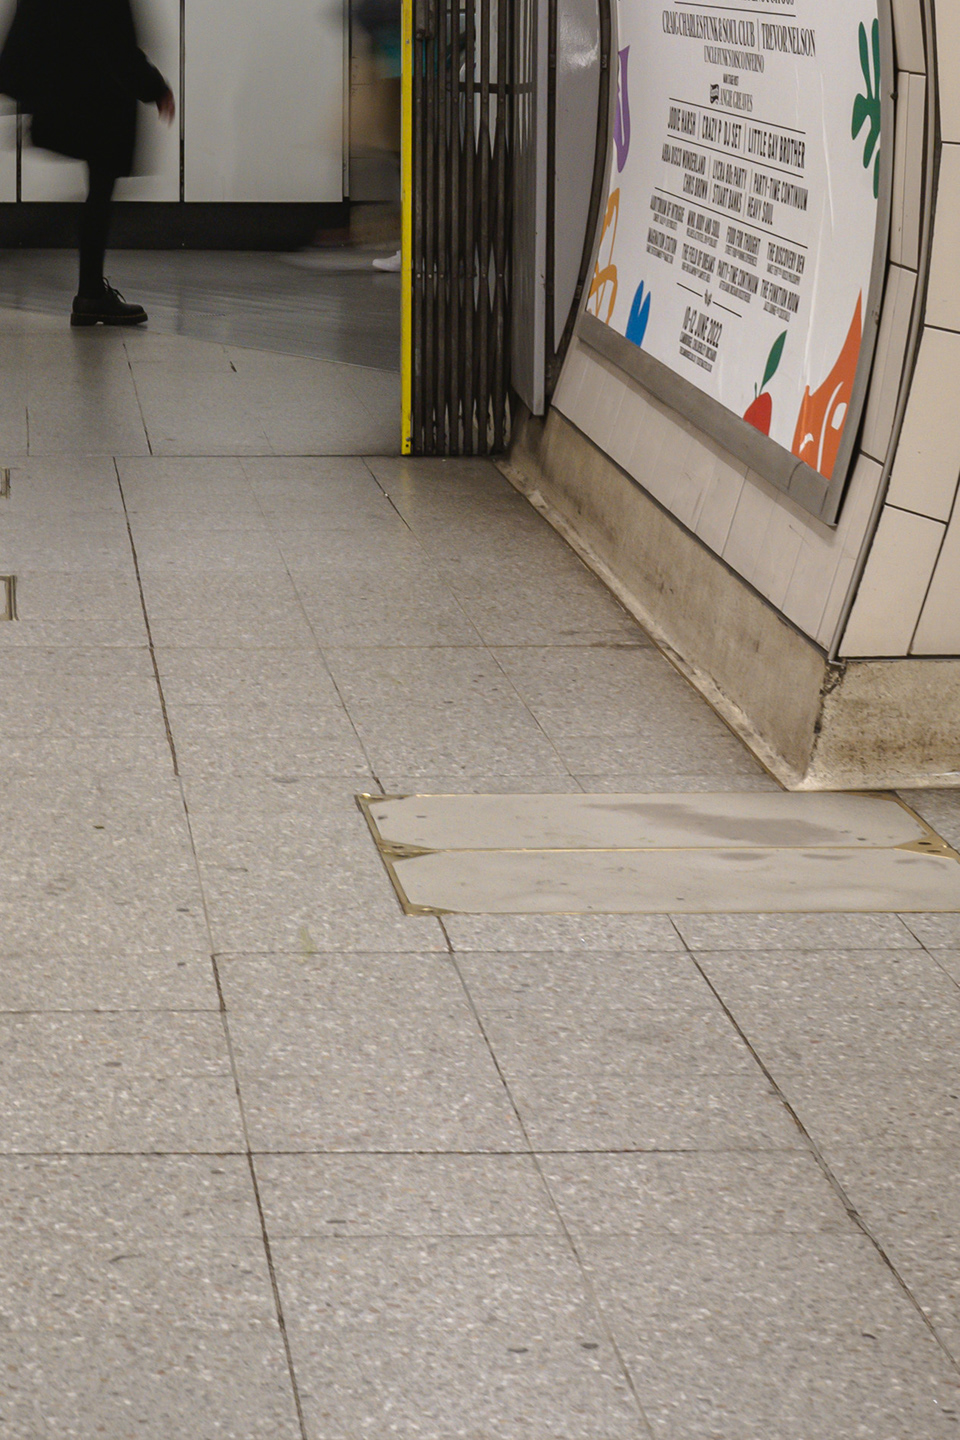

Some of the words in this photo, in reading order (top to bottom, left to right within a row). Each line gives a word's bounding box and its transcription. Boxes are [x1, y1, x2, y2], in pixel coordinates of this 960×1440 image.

[738, 20, 756, 48] CLUB
[762, 22, 788, 52] TREVOR
[786, 26, 816, 57] NELSON
[731, 122, 742, 150] SET
[748, 126, 768, 158] LITTLE
[767, 132, 780, 160] GAY
[778, 135, 806, 169] BROTHER
